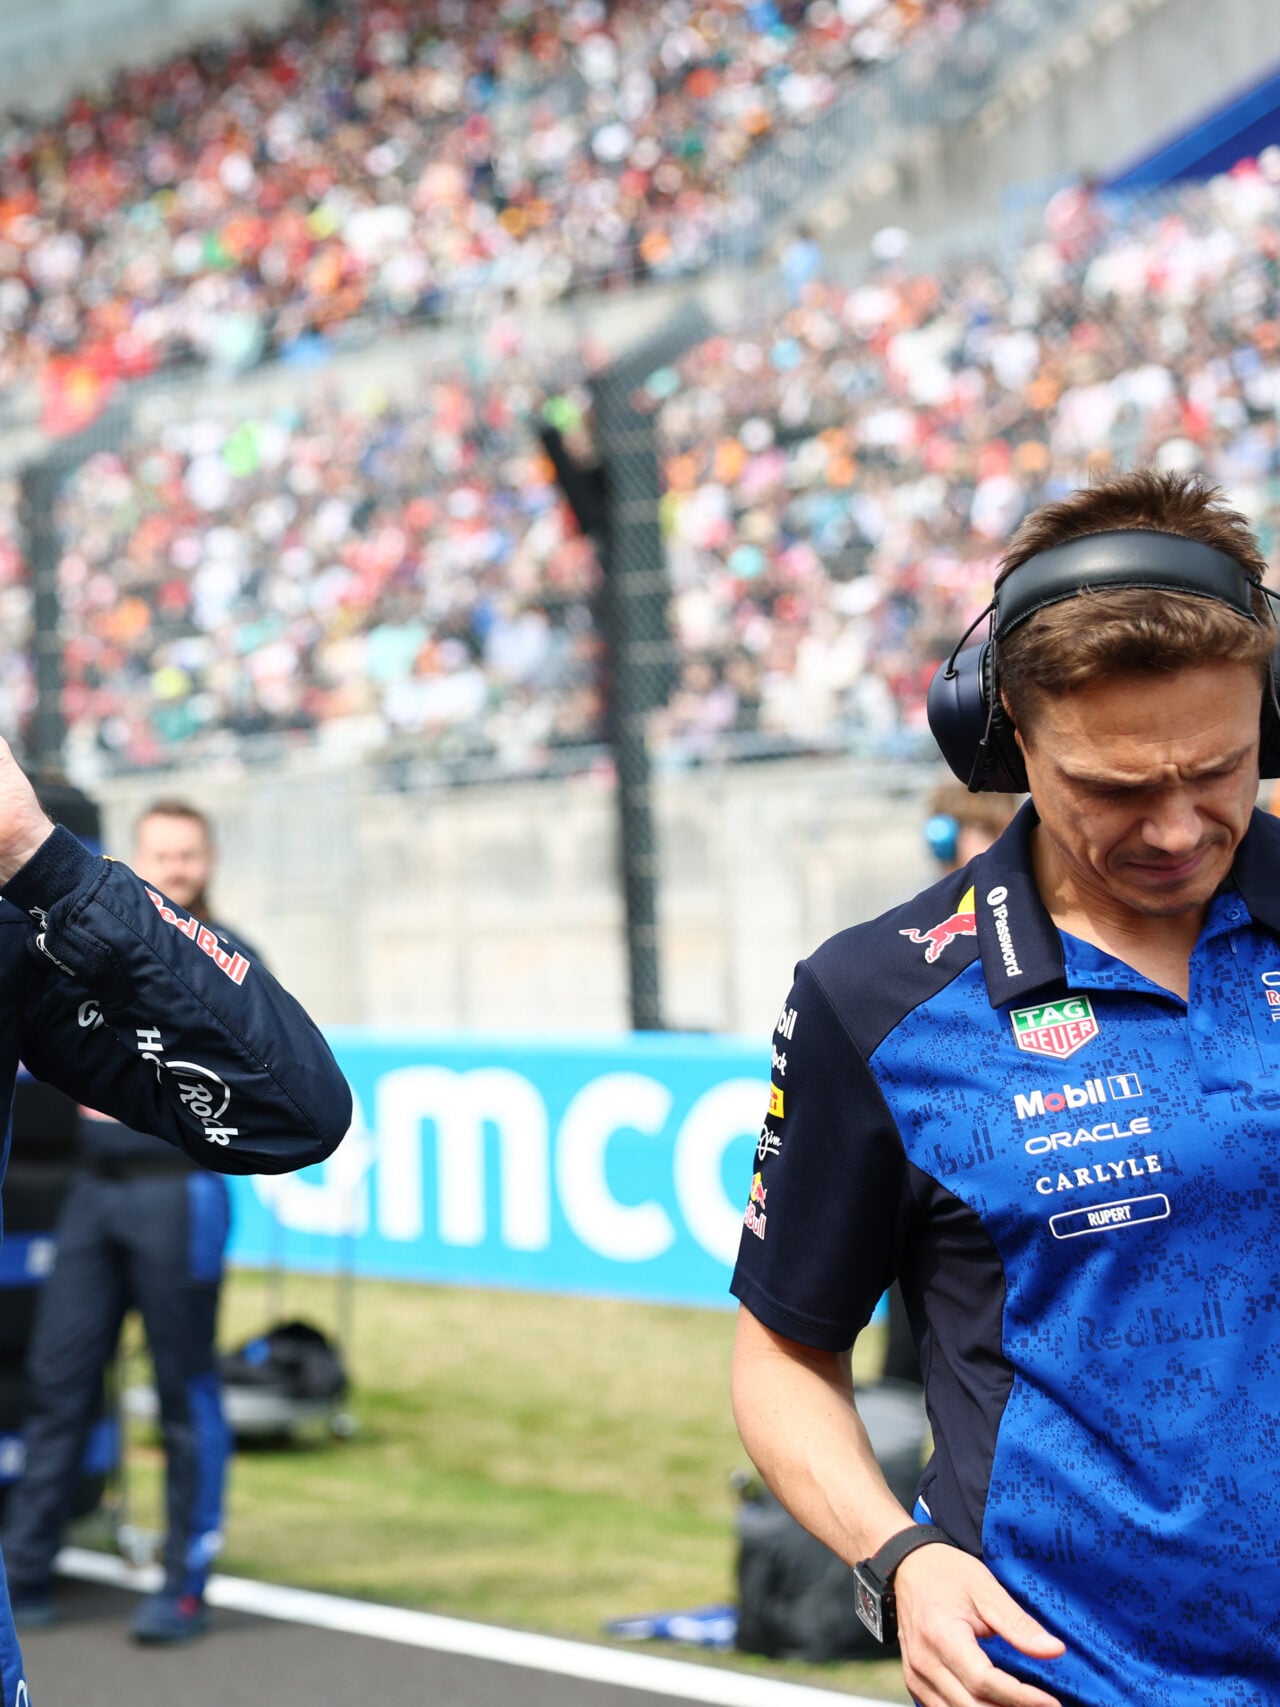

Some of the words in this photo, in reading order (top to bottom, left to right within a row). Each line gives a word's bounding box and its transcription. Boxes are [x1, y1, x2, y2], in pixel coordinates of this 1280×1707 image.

[992, 903, 1024, 977] 1Password
[777, 1002, 798, 1041] bil
[1018, 1001, 1086, 1028] TAG
[1020, 1020, 1095, 1053] HEUER
[1013, 1078, 1107, 1120] Mobil
[1024, 1116, 1153, 1155] ORACLE
[1035, 1154, 1162, 1195] CARLYLE
[1087, 1205, 1132, 1227] RUPERT
